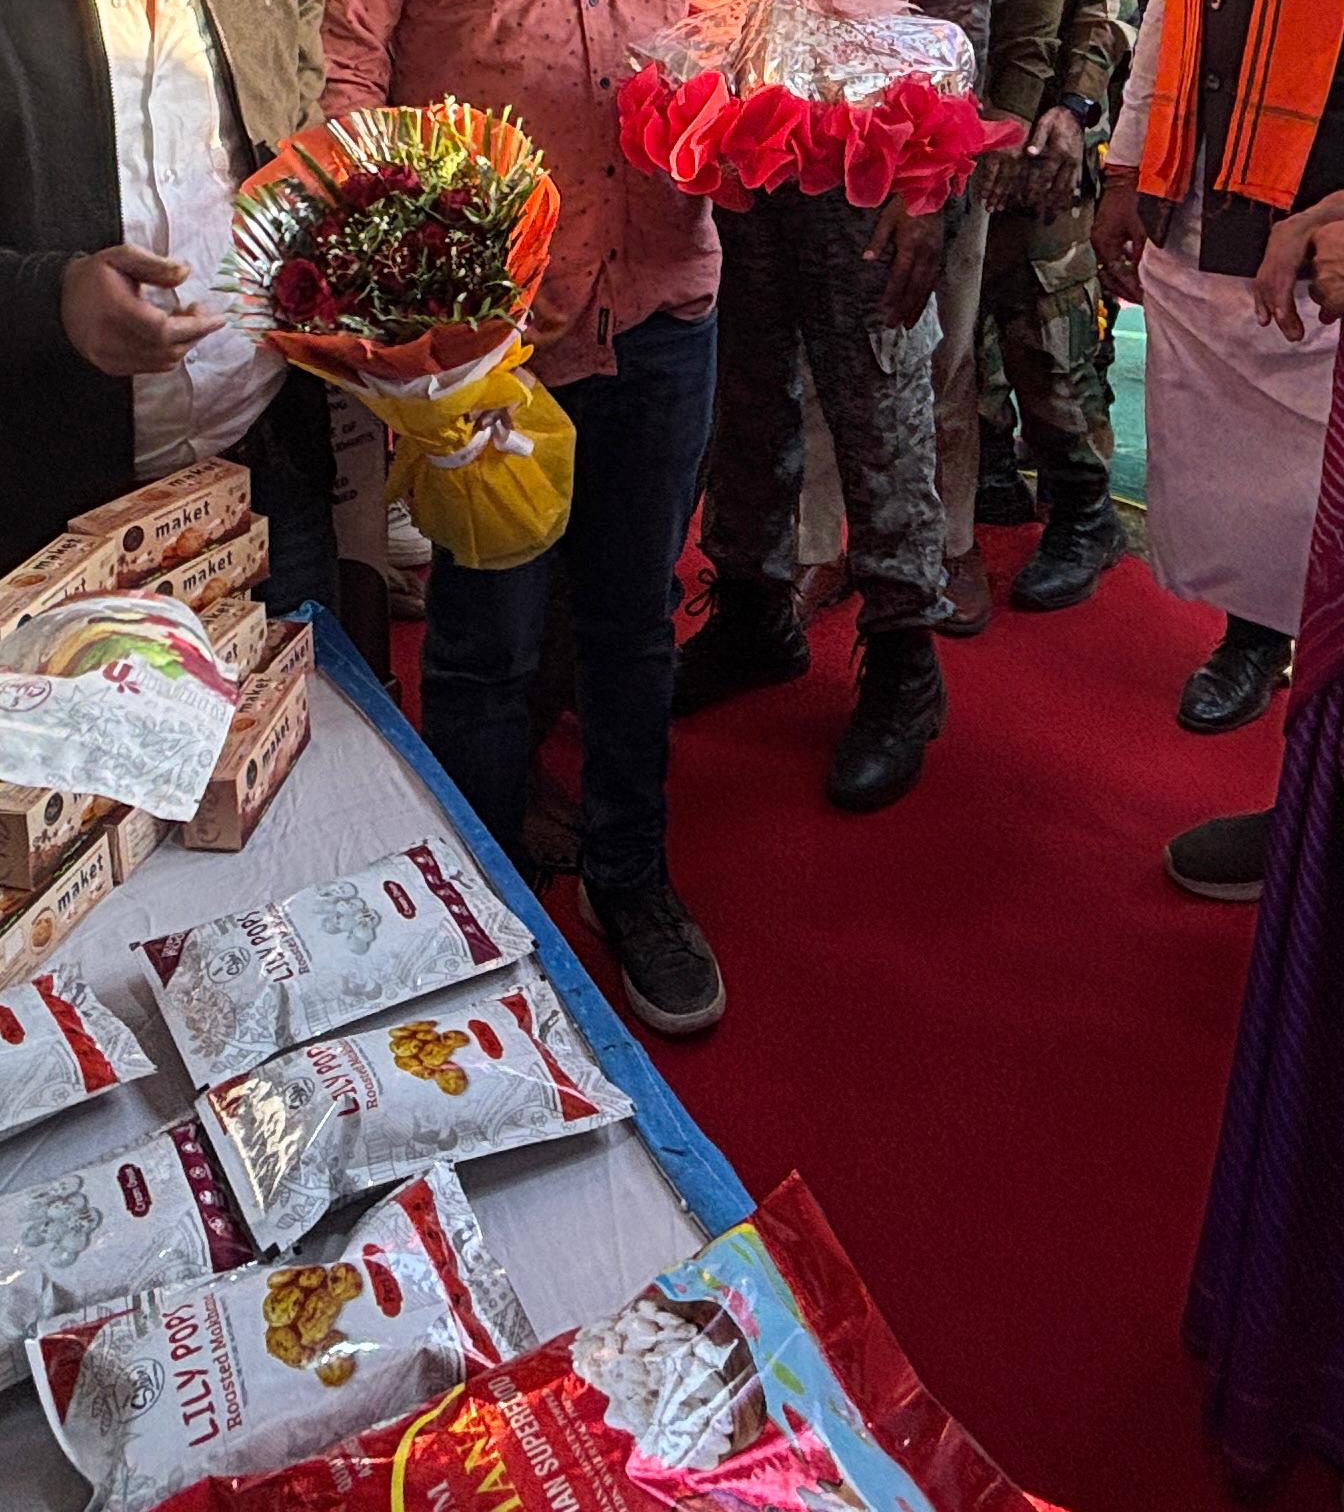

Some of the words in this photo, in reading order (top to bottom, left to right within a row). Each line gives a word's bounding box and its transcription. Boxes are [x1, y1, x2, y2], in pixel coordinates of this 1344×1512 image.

[156, 499, 211, 540] maket
[182, 549, 234, 592] maket
[238, 677, 272, 714] maket
[261, 715, 291, 768] maket
[57, 852, 105, 914] maket
[236, 910, 273, 956] POPS
[256, 944, 295, 984] LILY
[321, 1065, 361, 1118] LILY
[162, 1302, 204, 1363] POPS
[173, 1367, 221, 1448] LILY
[216, 1362, 244, 1432] Roasted
[448, 1396, 525, 1512] ANA
